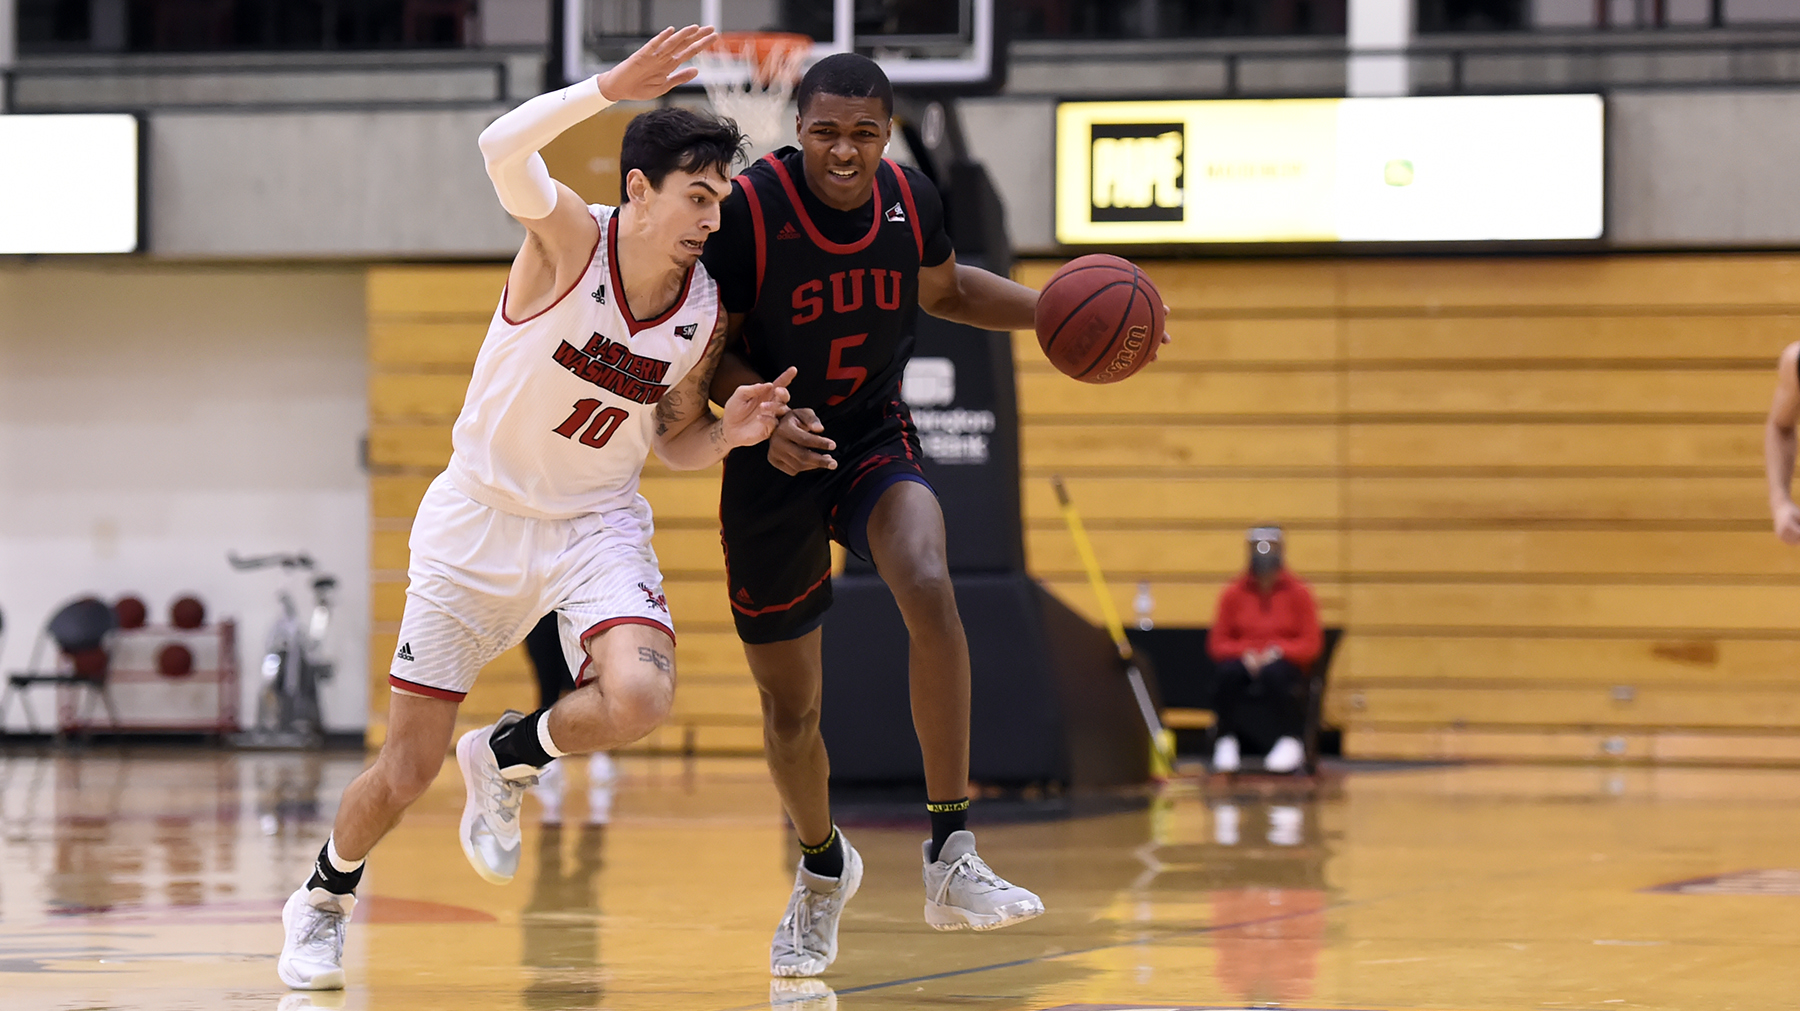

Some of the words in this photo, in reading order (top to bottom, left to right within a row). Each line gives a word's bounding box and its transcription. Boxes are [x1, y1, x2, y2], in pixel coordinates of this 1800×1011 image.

[791, 267, 902, 326] SUU
[552, 339, 671, 405] WASHINGTO
[580, 331, 672, 384] EASTERN
[825, 332, 869, 406] 5
[1097, 325, 1148, 382] Wilso
[552, 397, 630, 449] 10
